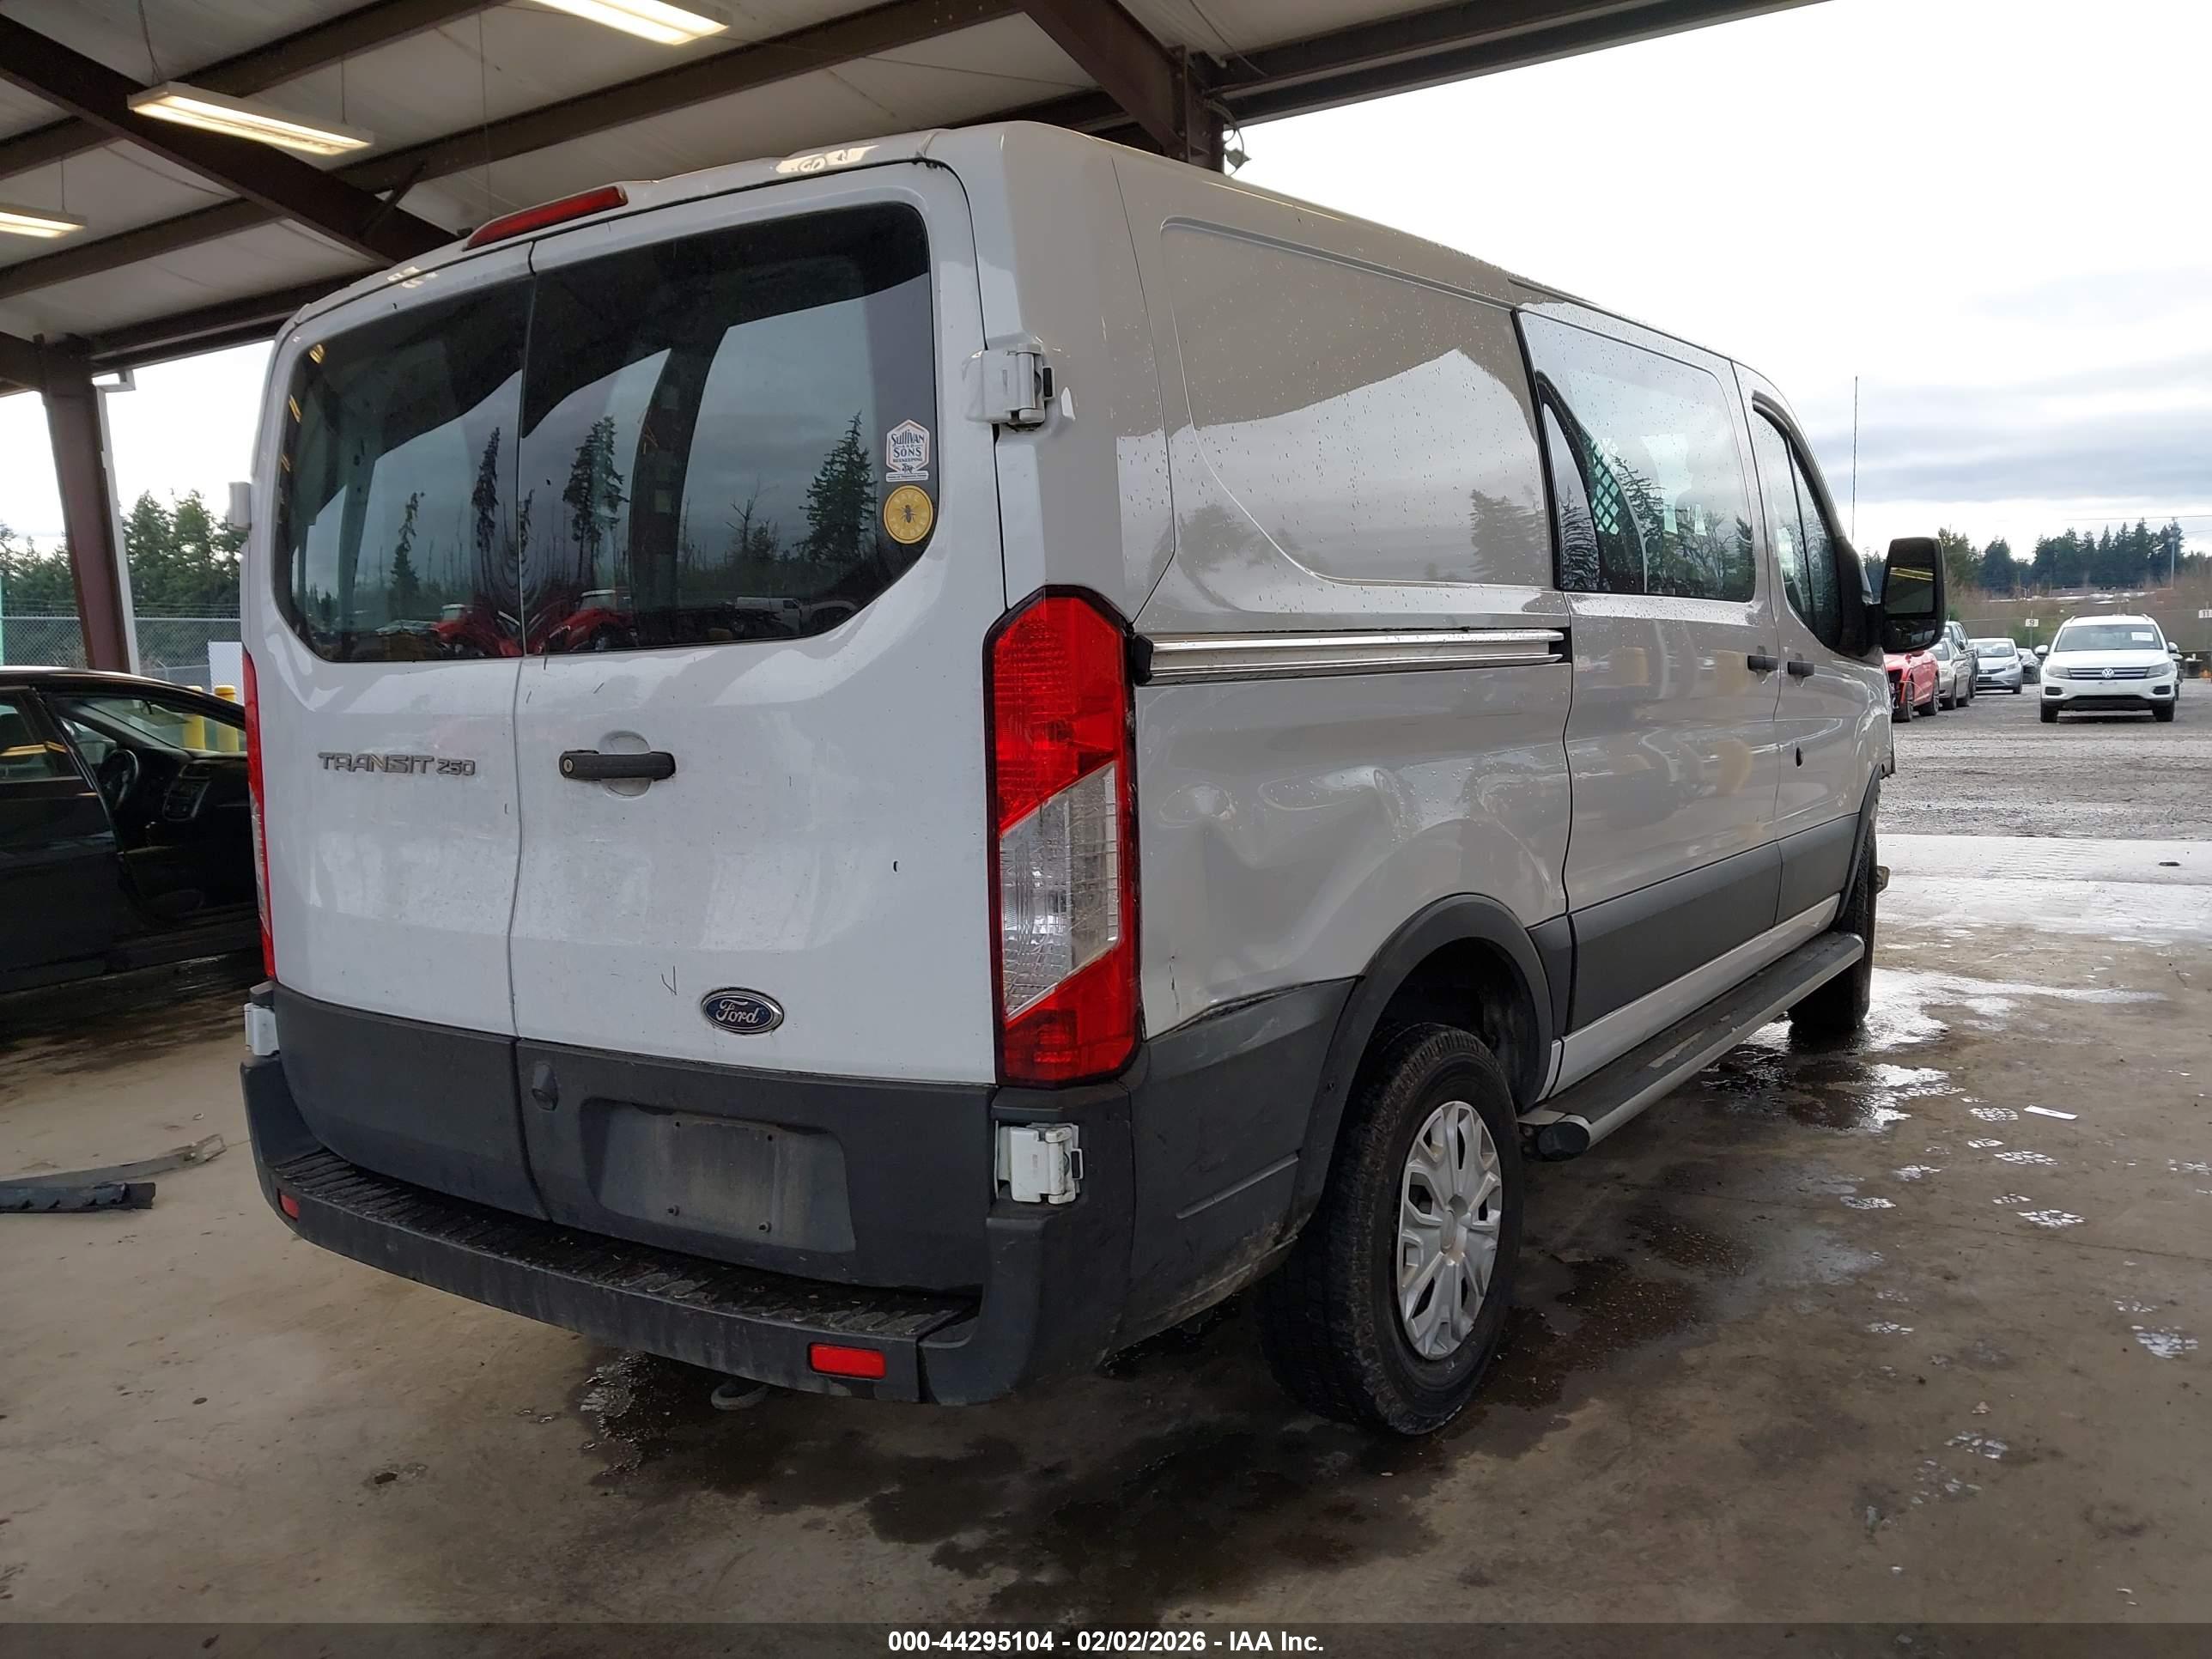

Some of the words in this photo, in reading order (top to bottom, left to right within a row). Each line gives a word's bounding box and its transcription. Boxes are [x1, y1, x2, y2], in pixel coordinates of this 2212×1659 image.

[893, 447, 922, 458] SONS
[318, 751, 434, 774] TRANSIT
[435, 758, 476, 776] 250
[715, 999, 760, 1024] Ford
